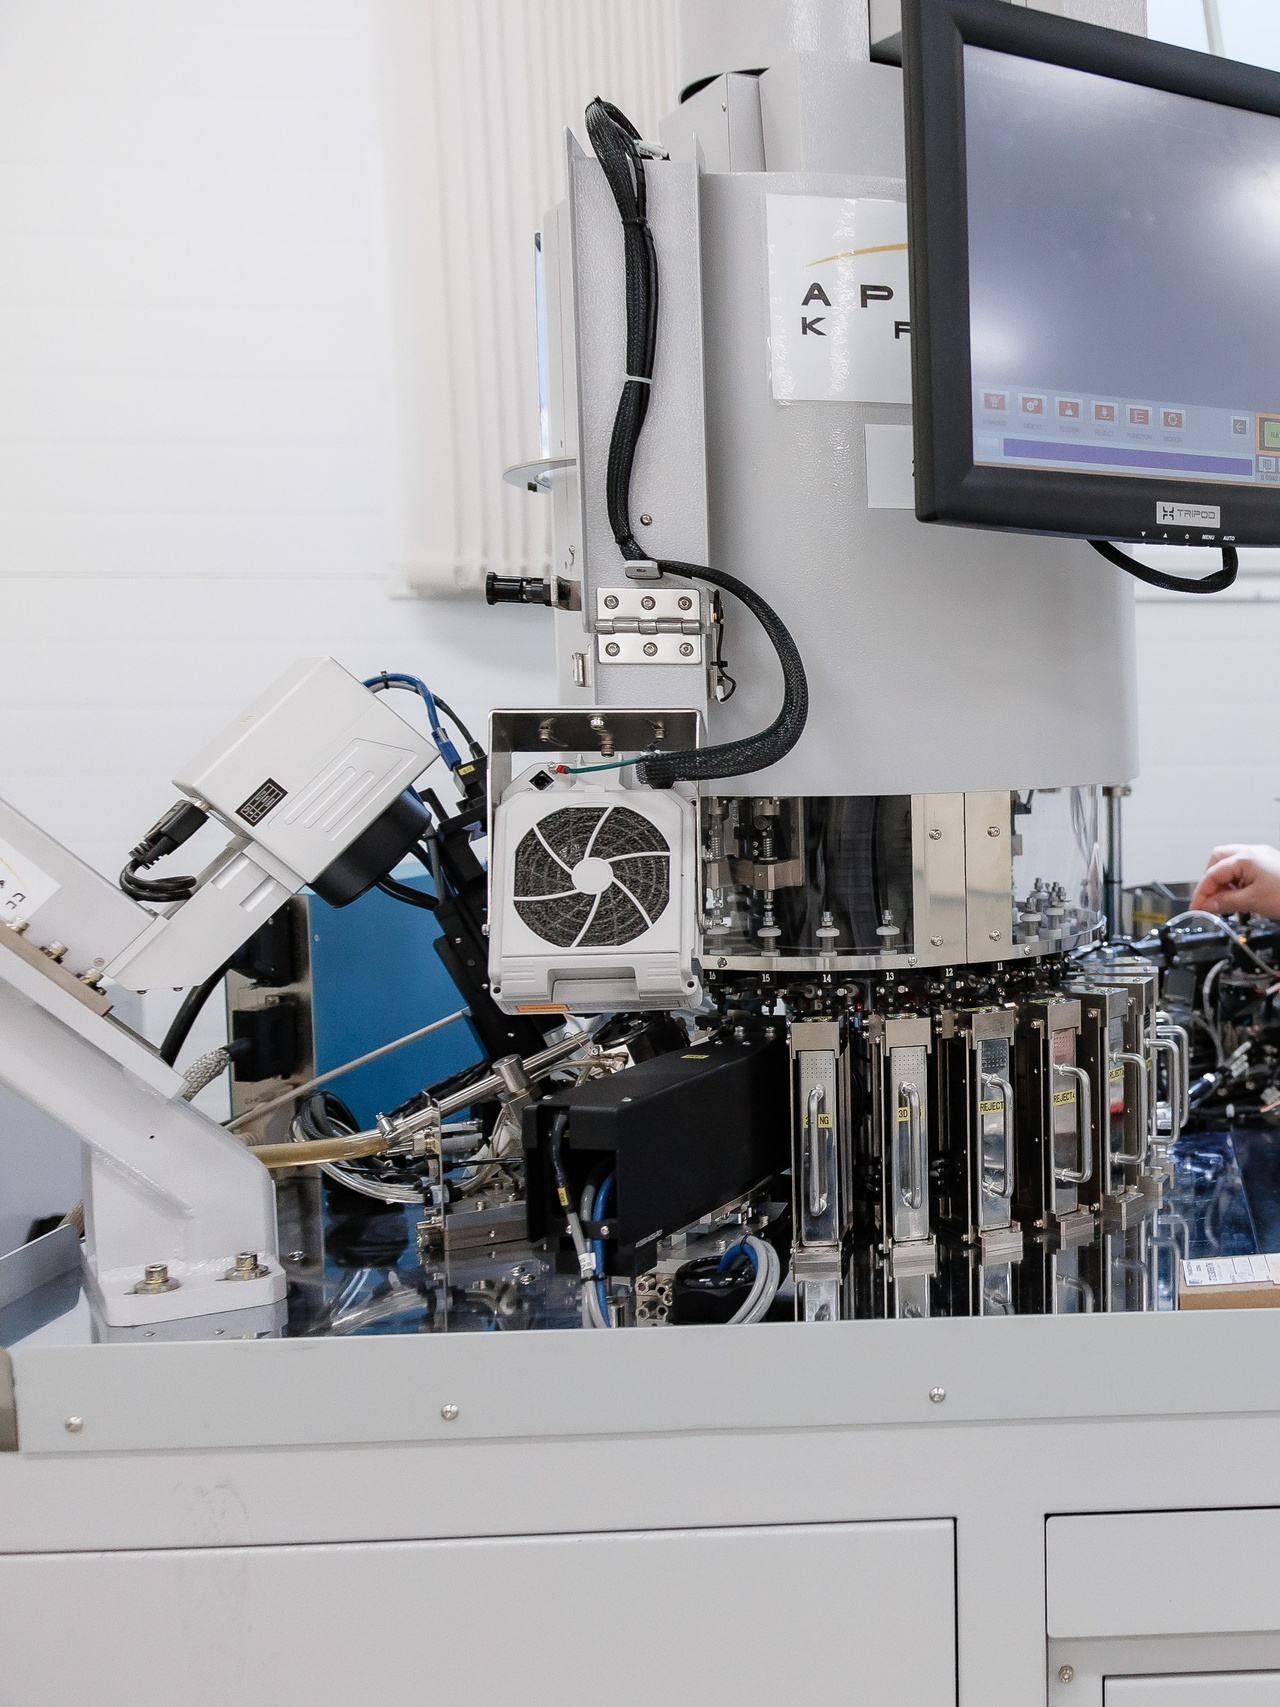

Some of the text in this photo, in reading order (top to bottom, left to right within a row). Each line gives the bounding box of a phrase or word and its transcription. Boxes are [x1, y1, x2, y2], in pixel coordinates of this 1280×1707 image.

[1177, 509, 1216, 520] TRIPOD
[997, 963, 1003, 971] 11
[708, 971, 717, 980] 16
[885, 972, 895, 981] 13
[944, 968, 954, 977] 12
[762, 973, 770, 983] 15
[822, 974, 831, 983] 14
[819, 1117, 829, 1125] NG
